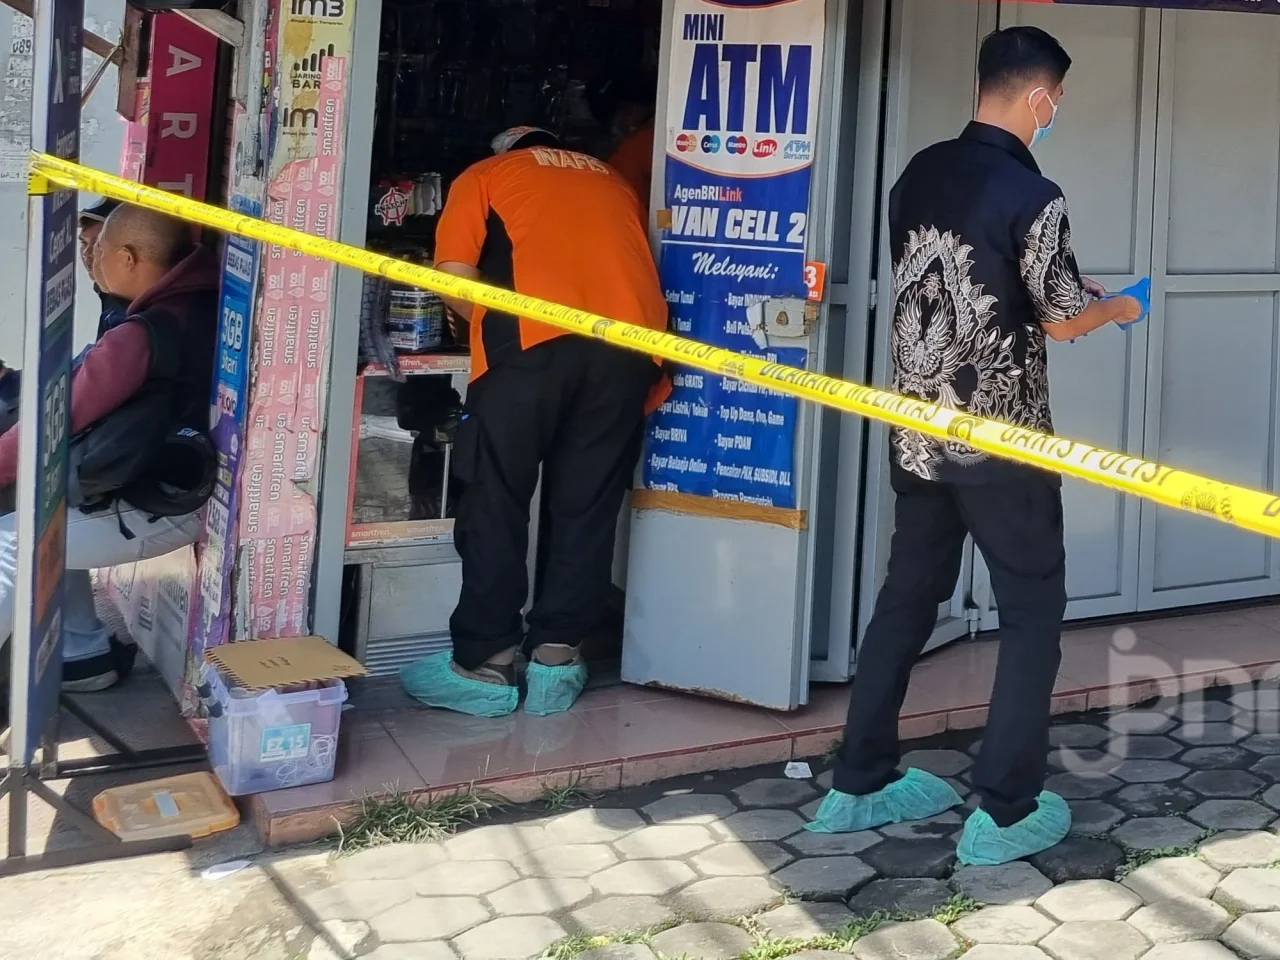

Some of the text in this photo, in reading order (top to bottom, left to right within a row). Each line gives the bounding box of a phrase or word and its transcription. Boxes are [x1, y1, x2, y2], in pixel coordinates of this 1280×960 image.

[683, 13, 725, 41] MINI
[682, 43, 813, 135] ATM
[322, 98, 336, 156] smartfren
[754, 140, 776, 154] Link
[671, 205, 806, 241] VAN CELL 2
[674, 184, 742, 203] AgenBRILink
[692, 251, 778, 283] Melayani:
[263, 306, 276, 367] smartfren
[284, 305, 298, 365] smartfren
[307, 308, 320, 368] smartfren
[269, 432, 286, 501] smartfren
[1085, 447, 1175, 487] POLISI
[247, 464, 264, 533] smartfren
[264, 537, 276, 598] smartfren
[280, 536, 293, 596] smartfren
[295, 535, 311, 594] smartfren
